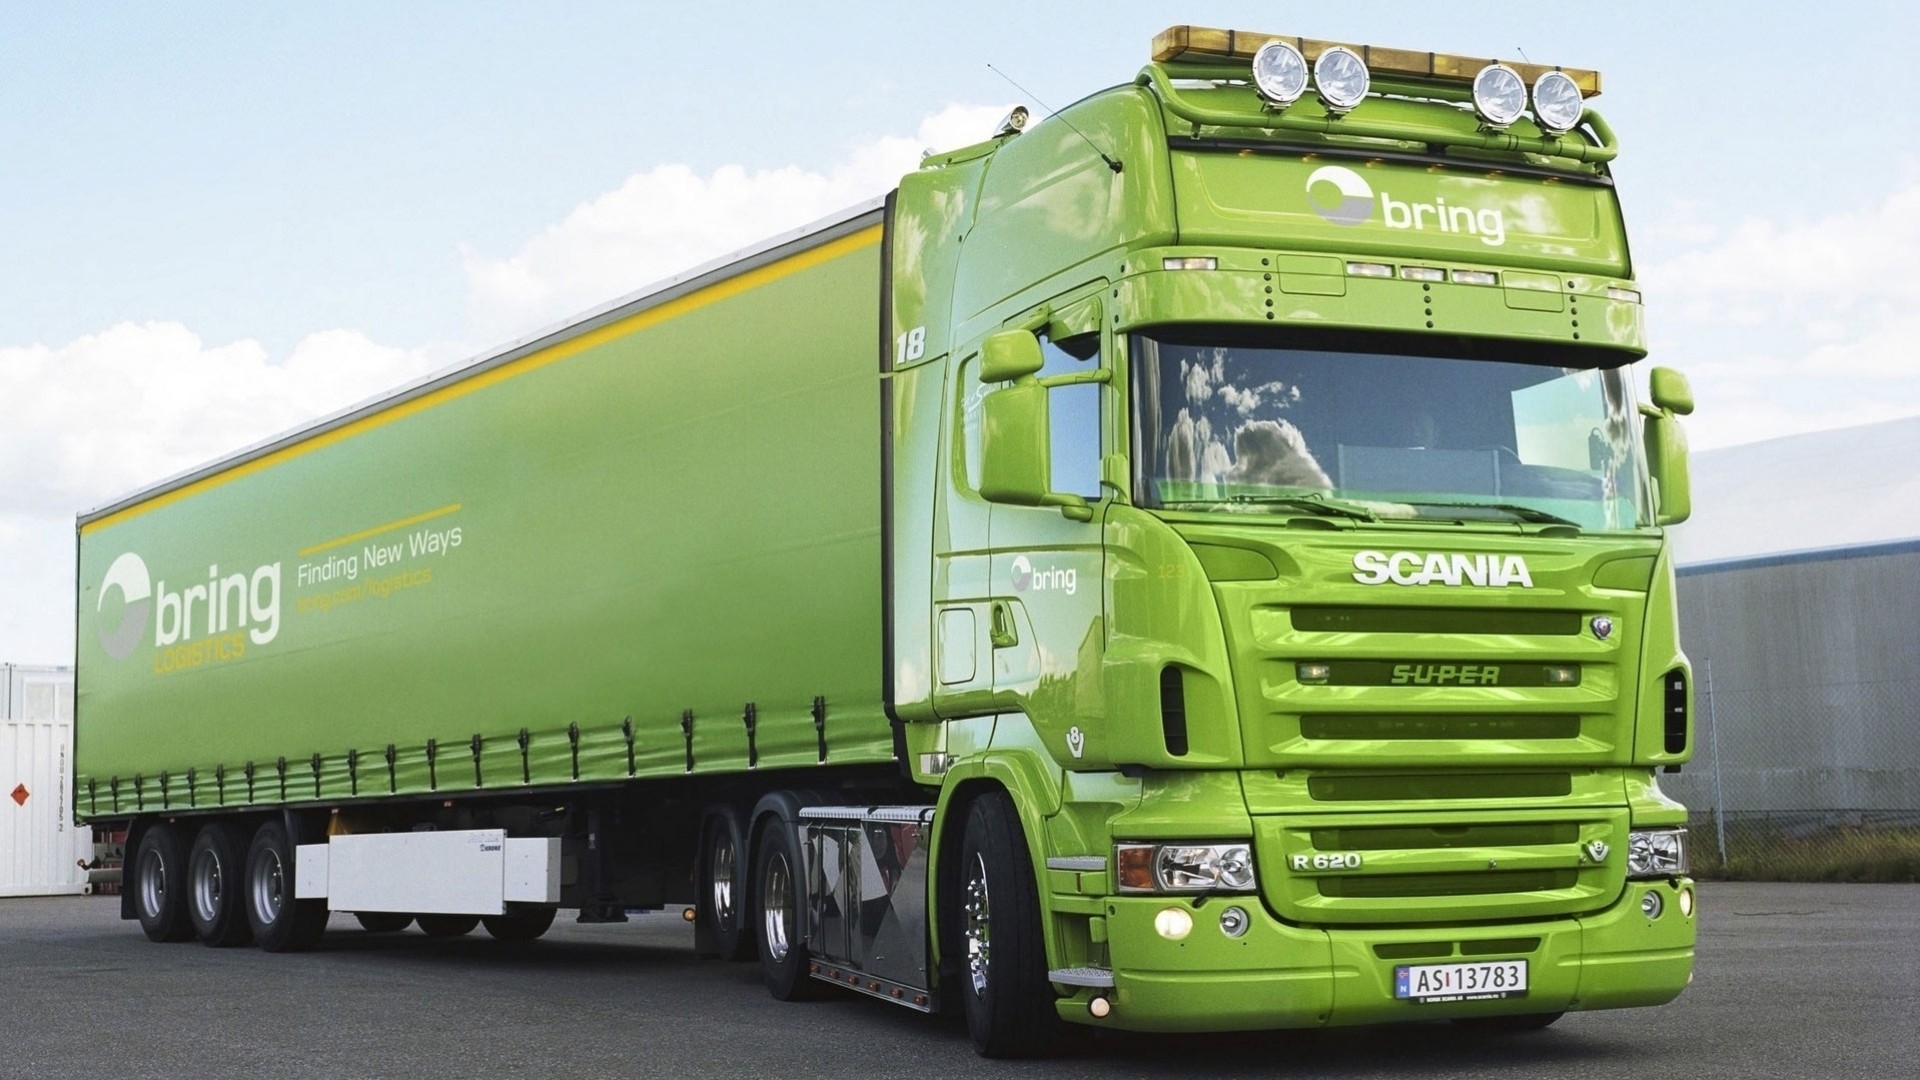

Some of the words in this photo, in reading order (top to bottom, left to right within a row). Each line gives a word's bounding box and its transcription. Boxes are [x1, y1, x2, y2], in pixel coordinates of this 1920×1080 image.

[1381, 192, 1505, 246] bring
[897, 326, 927, 364] 18
[298, 554, 357, 588] Finding
[364, 540, 403, 570] New
[409, 526, 462, 558] Ways
[1352, 550, 1534, 588] SCANIA
[1032, 565, 1076, 595] bring
[155, 562, 281, 646] bring
[153, 632, 246, 674] LOGISTICS
[1391, 664, 1500, 685] SUPER
[1292, 855, 1310, 870] R
[1312, 854, 1362, 870] 620
[1417, 969, 1443, 993] AS
[1455, 966, 1519, 989] 13783
